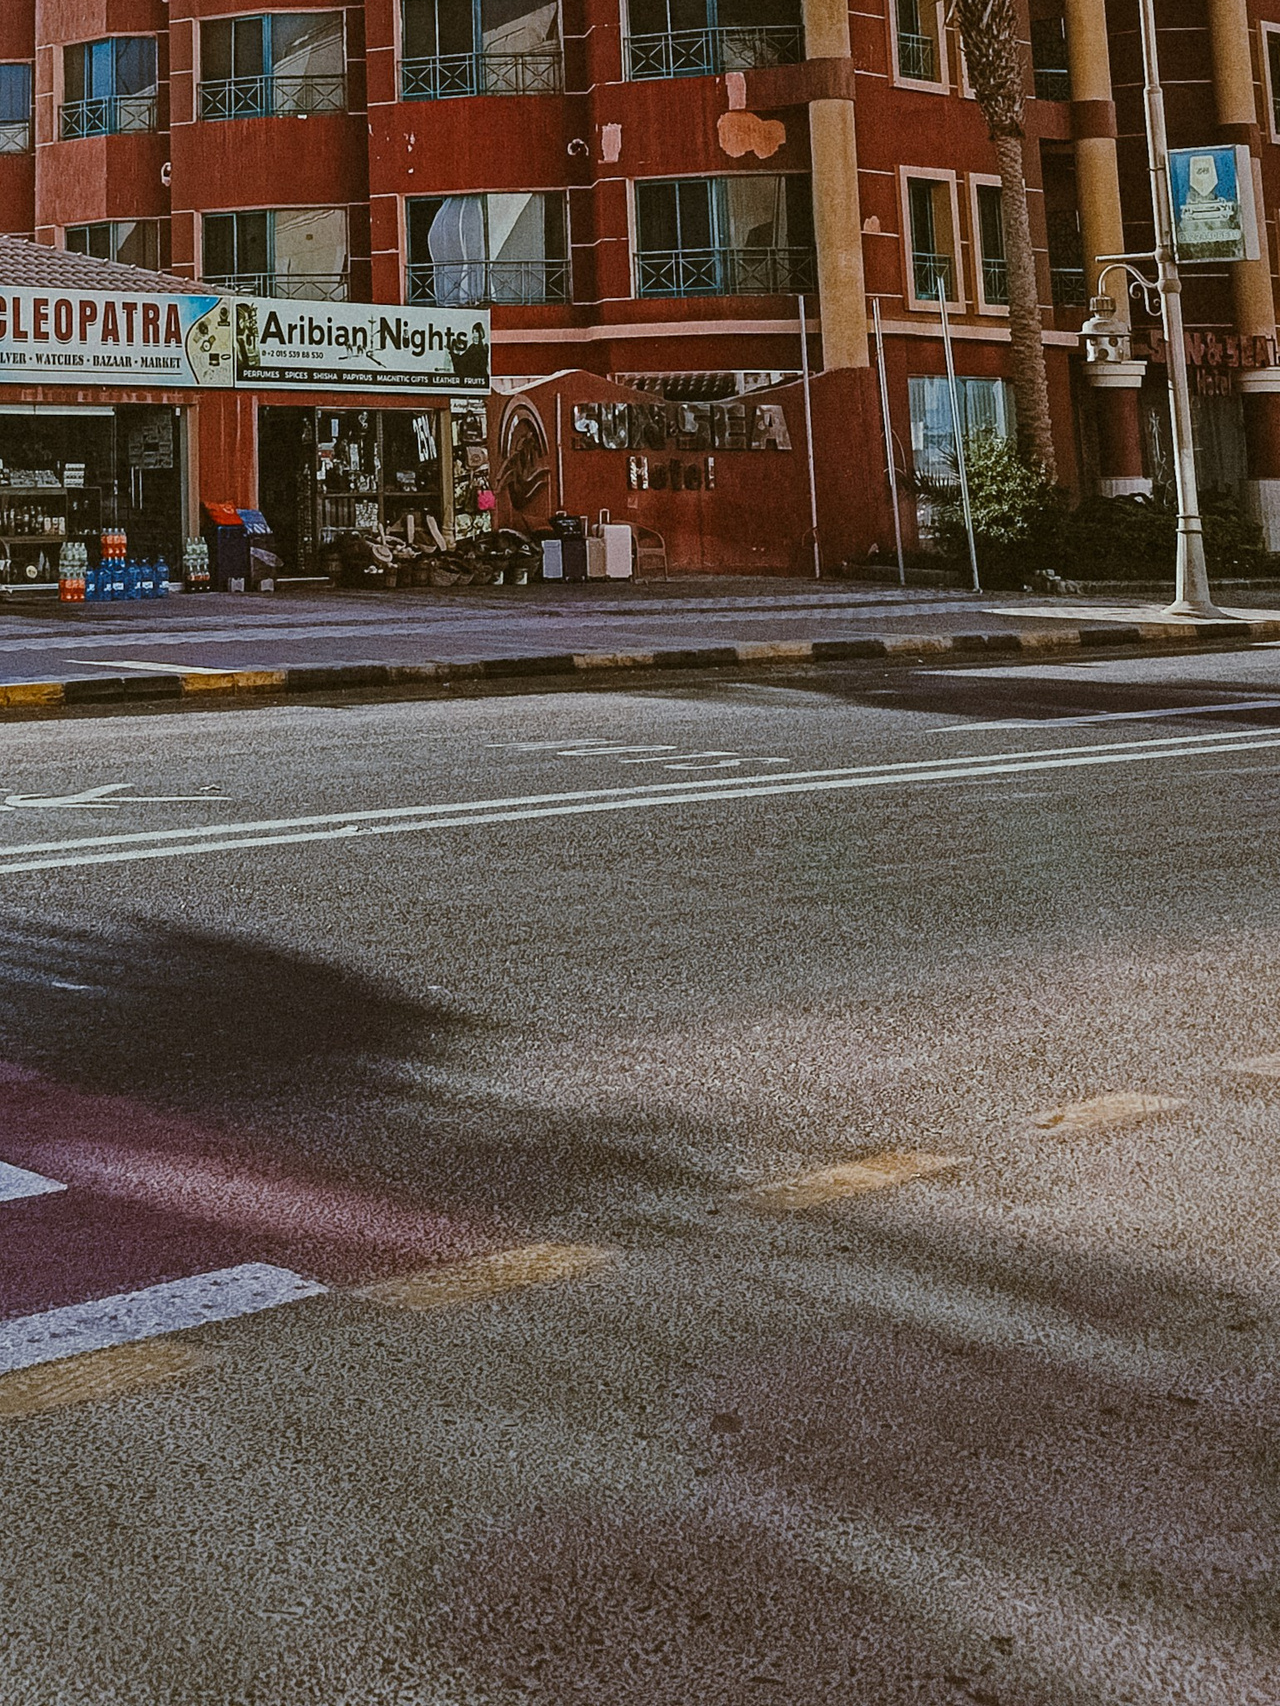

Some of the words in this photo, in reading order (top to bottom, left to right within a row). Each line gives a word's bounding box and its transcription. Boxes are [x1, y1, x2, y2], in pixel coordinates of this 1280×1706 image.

[260, 311, 368, 346] Aribian
[379, 317, 468, 356] Nights
[35, 353, 84, 366] WATCHES
[92, 355, 132, 368] BAZAAR
[140, 356, 182, 369] MARKET
[276, 350, 287, 358] 015
[302, 351, 310, 359] 88
[311, 351, 324, 359] 530
[243, 369, 280, 379] PERFUMES
[284, 370, 308, 380] SPICES
[313, 371, 338, 380] SHISHA
[342, 372, 373, 381] PAPYRUS
[376, 373, 410, 383] MAGNETIC
[410, 374, 429, 383] GIFTS
[432, 375, 460, 384] LEATHER
[463, 376, 486, 385] FRUITS
